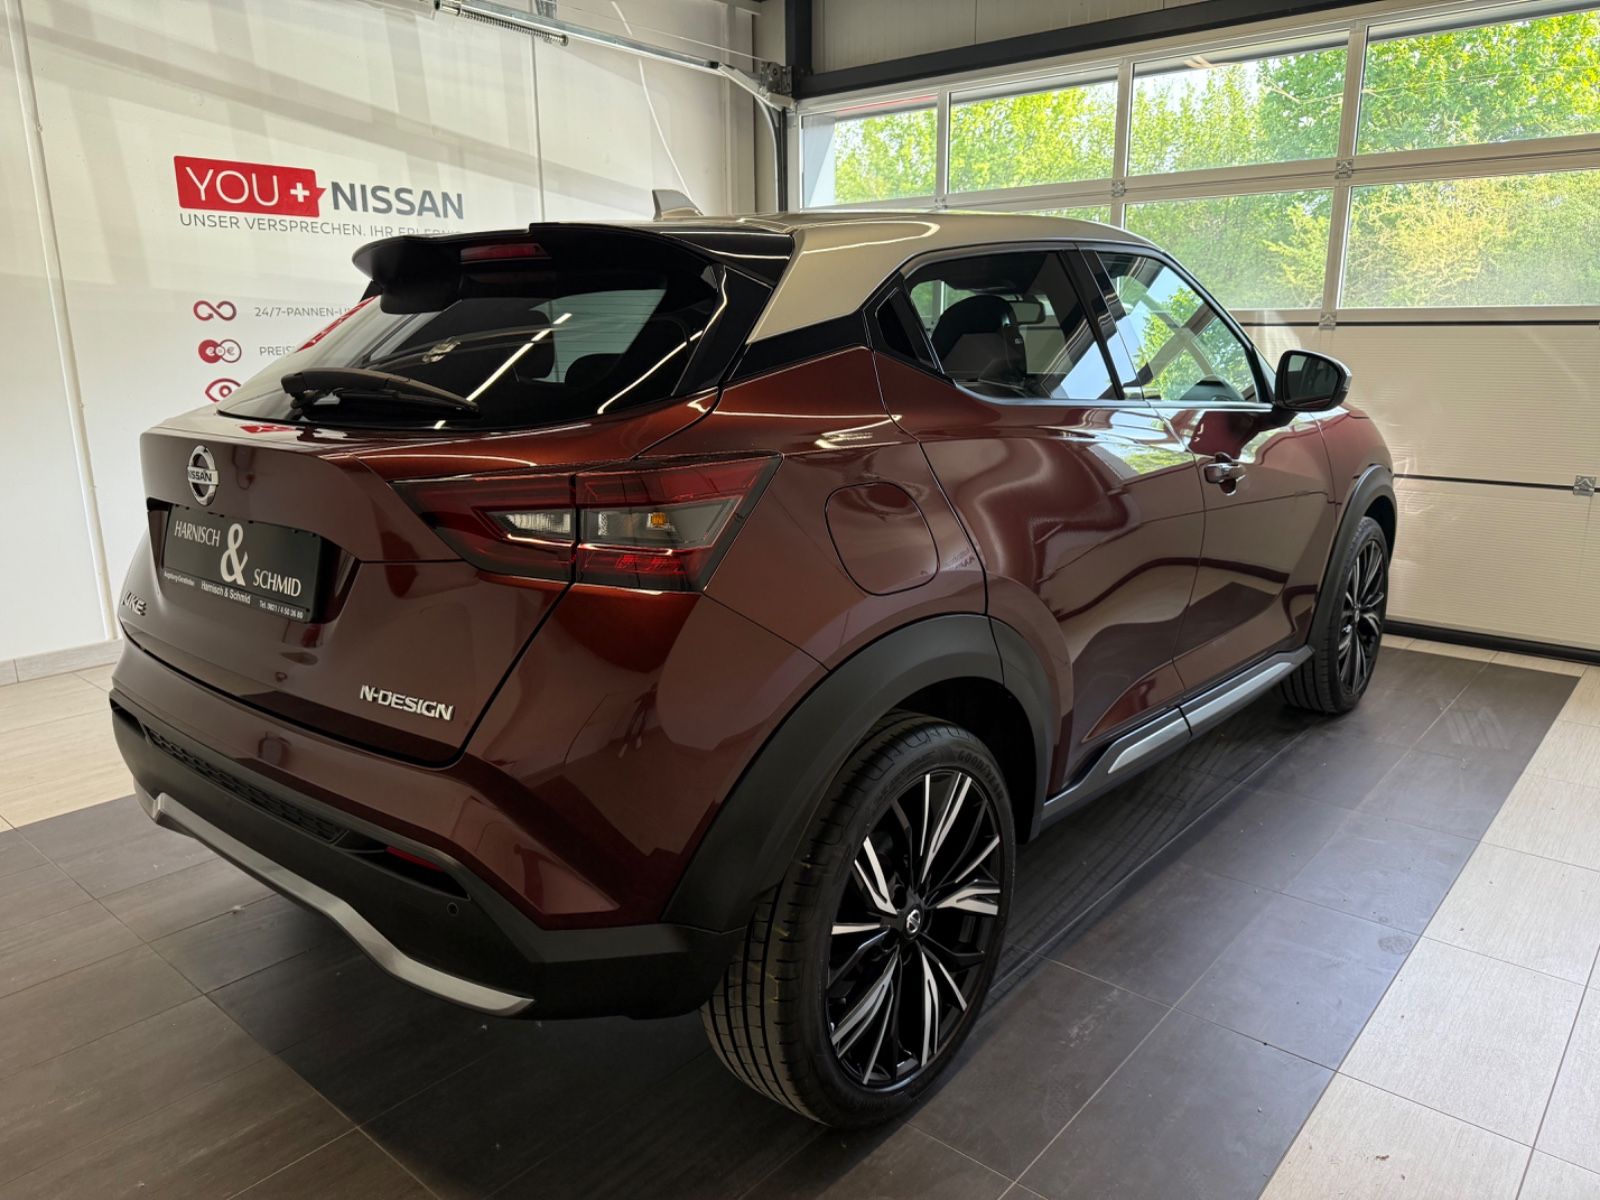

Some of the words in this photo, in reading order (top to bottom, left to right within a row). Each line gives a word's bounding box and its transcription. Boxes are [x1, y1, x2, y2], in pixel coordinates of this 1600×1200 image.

[331, 180, 465, 220] NISSAN
[179, 212, 241, 230] UNSER
[244, 217, 366, 237] VERSPRECHEN.
[370, 225, 394, 239] IHR
[174, 520, 222, 547] HARNISCH
[220, 523, 249, 587] &
[252, 568, 302, 597] SCHMID
[201, 580, 224, 596] Harnisch
[229, 589, 251, 605] Schmid
[359, 684, 455, 721] N-DESIGN
